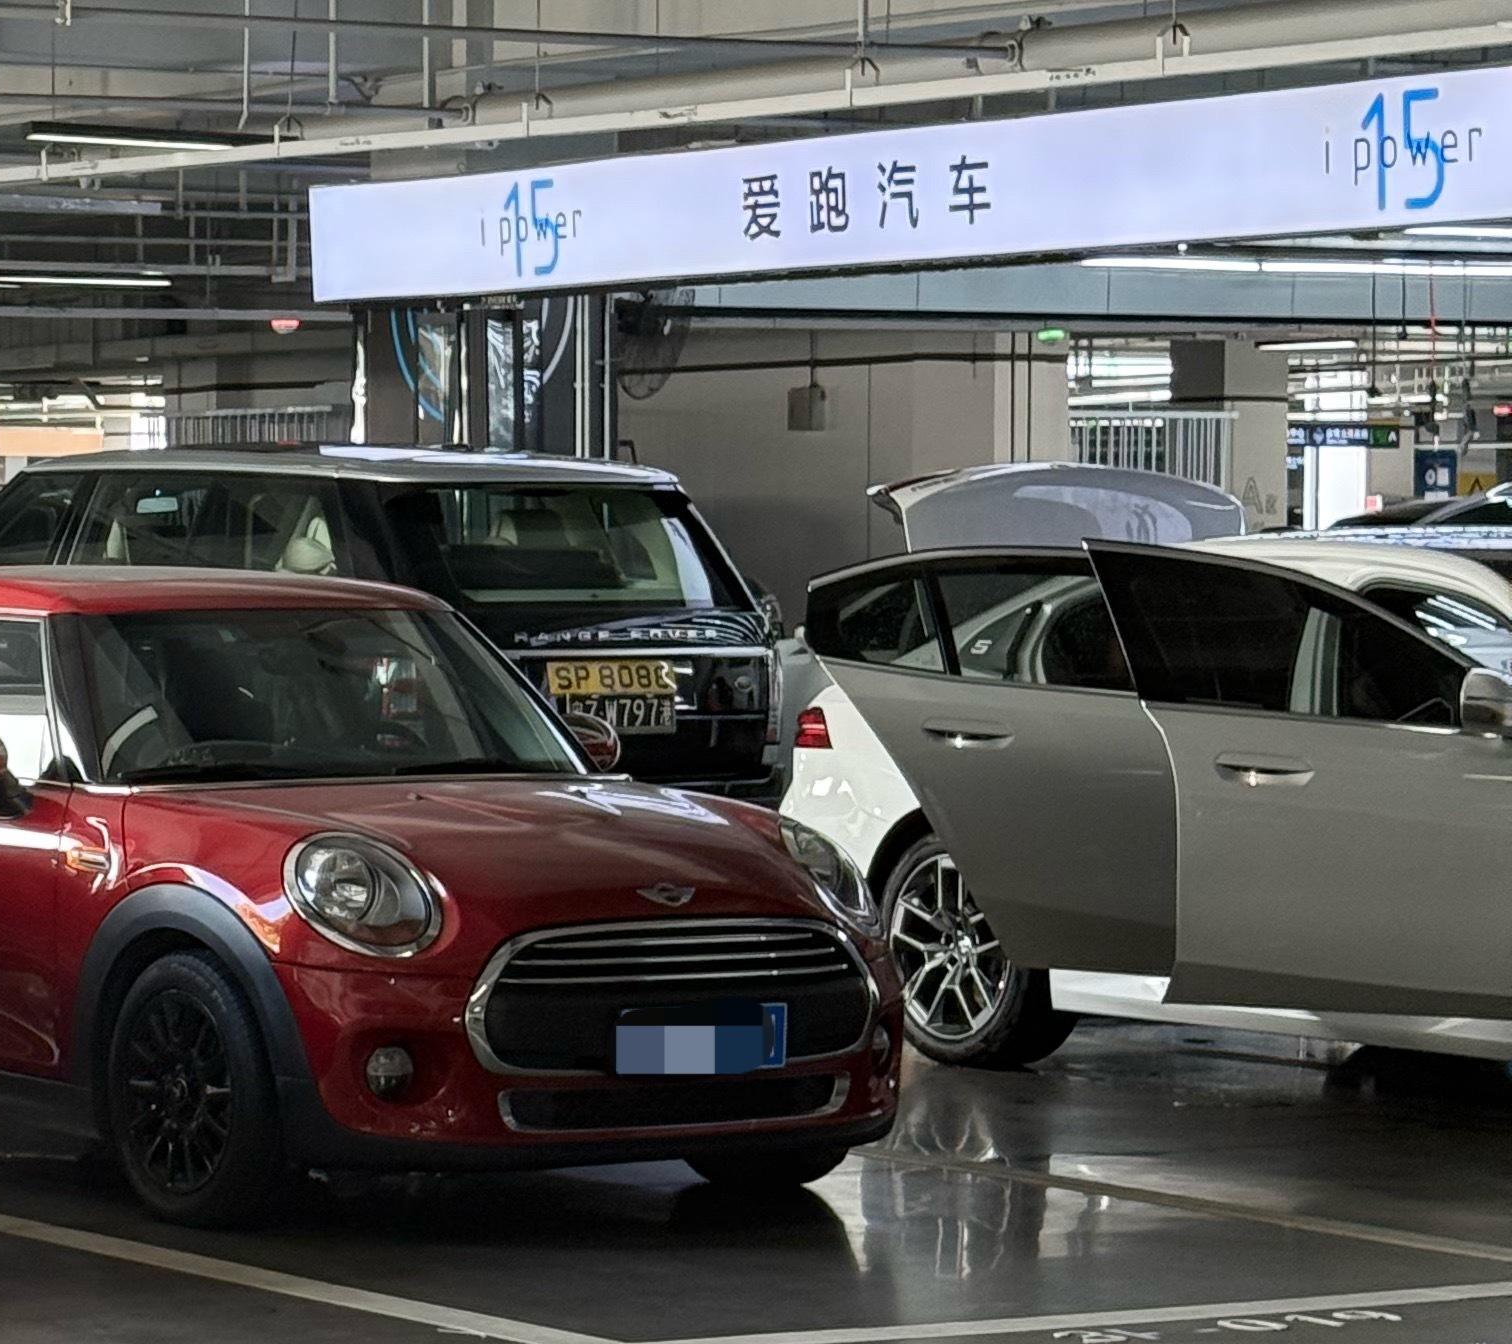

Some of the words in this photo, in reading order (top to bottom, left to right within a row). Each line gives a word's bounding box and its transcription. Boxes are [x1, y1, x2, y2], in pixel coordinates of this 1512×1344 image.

[741, 154, 992, 241] 爱跑汽车
[555, 665, 590, 690] SP
